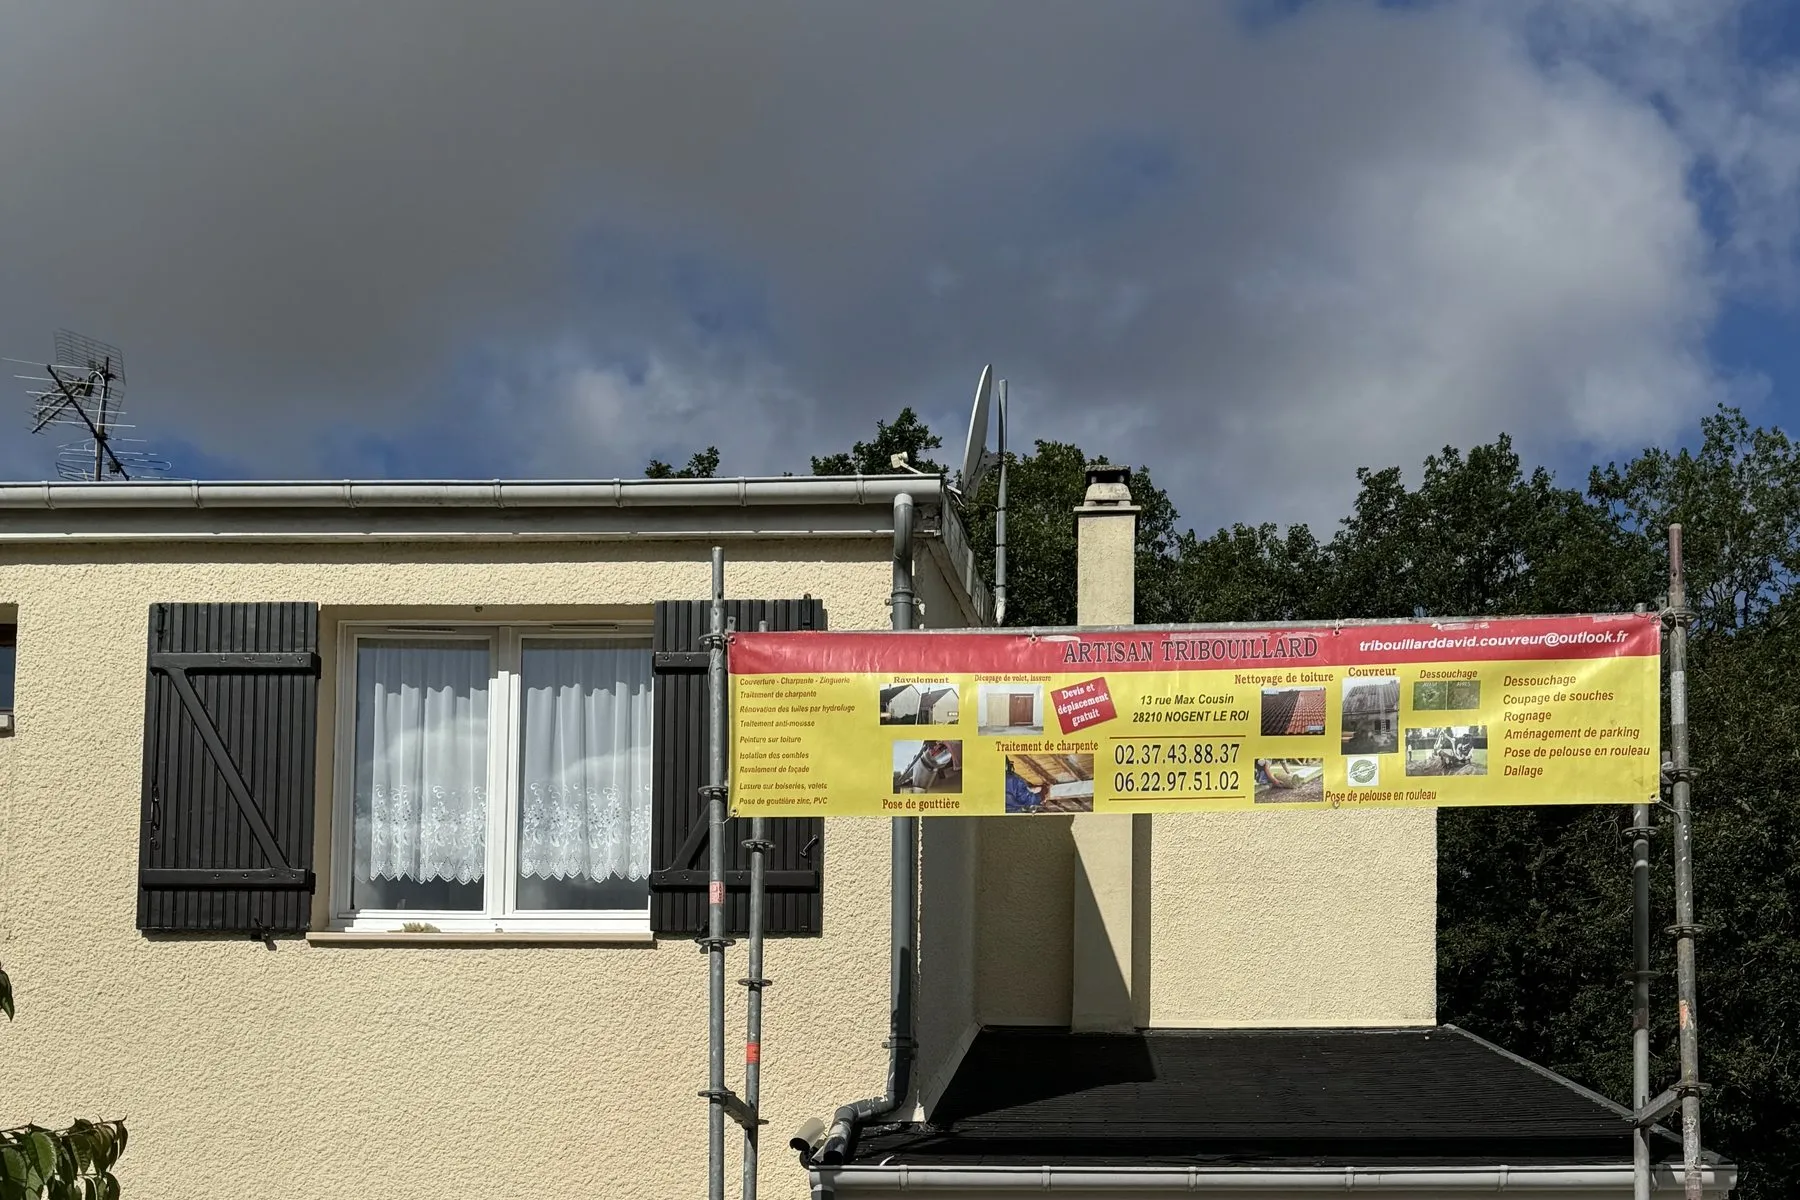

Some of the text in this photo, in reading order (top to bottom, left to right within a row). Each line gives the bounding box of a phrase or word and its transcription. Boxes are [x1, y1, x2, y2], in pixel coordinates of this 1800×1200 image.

[1359, 631, 1628, 652] tribouillarddavid.couvreur@outlook.fr
[1064, 637, 1318, 663] ARTISAN TRIBOUILLARD
[1003, 674, 1011, 682] de
[1348, 667, 1396, 678] Couvreur
[1419, 669, 1478, 680] Dessouchage
[894, 676, 949, 684] Ravalement
[1234, 673, 1334, 687] Nettoyage de toiture
[1503, 675, 1577, 687] Dessouchage
[775, 690, 783, 698] de
[784, 690, 817, 699] charpente
[1061, 683, 1095, 699] Devis et
[1057, 692, 1109, 715] déplacement
[1140, 693, 1234, 705] 13 rue Max Cousin
[1503, 690, 1614, 706] Coupage de souches
[810, 705, 820, 714] par
[1072, 709, 1100, 727] gratuit
[1133, 710, 1249, 723] 28210 NOGENT LE ROI
[1504, 711, 1552, 723] Rognage
[740, 736, 766, 744] Peinture
[1504, 726, 1640, 741] Aménagement de parking
[995, 739, 1098, 754] Traitement de charpente
[1504, 745, 1650, 759] Pose de pelouse en rouleau
[1114, 743, 1240, 765] 02.37.43.88.37
[1504, 765, 1543, 778] Dallage
[1114, 770, 1240, 792] 06.22.97.51.02
[739, 797, 755, 805] Pose
[756, 797, 765, 805] de
[1325, 789, 1437, 804] Pose de pelouse en rouleau
[882, 798, 960, 811] Pose de gouttière
